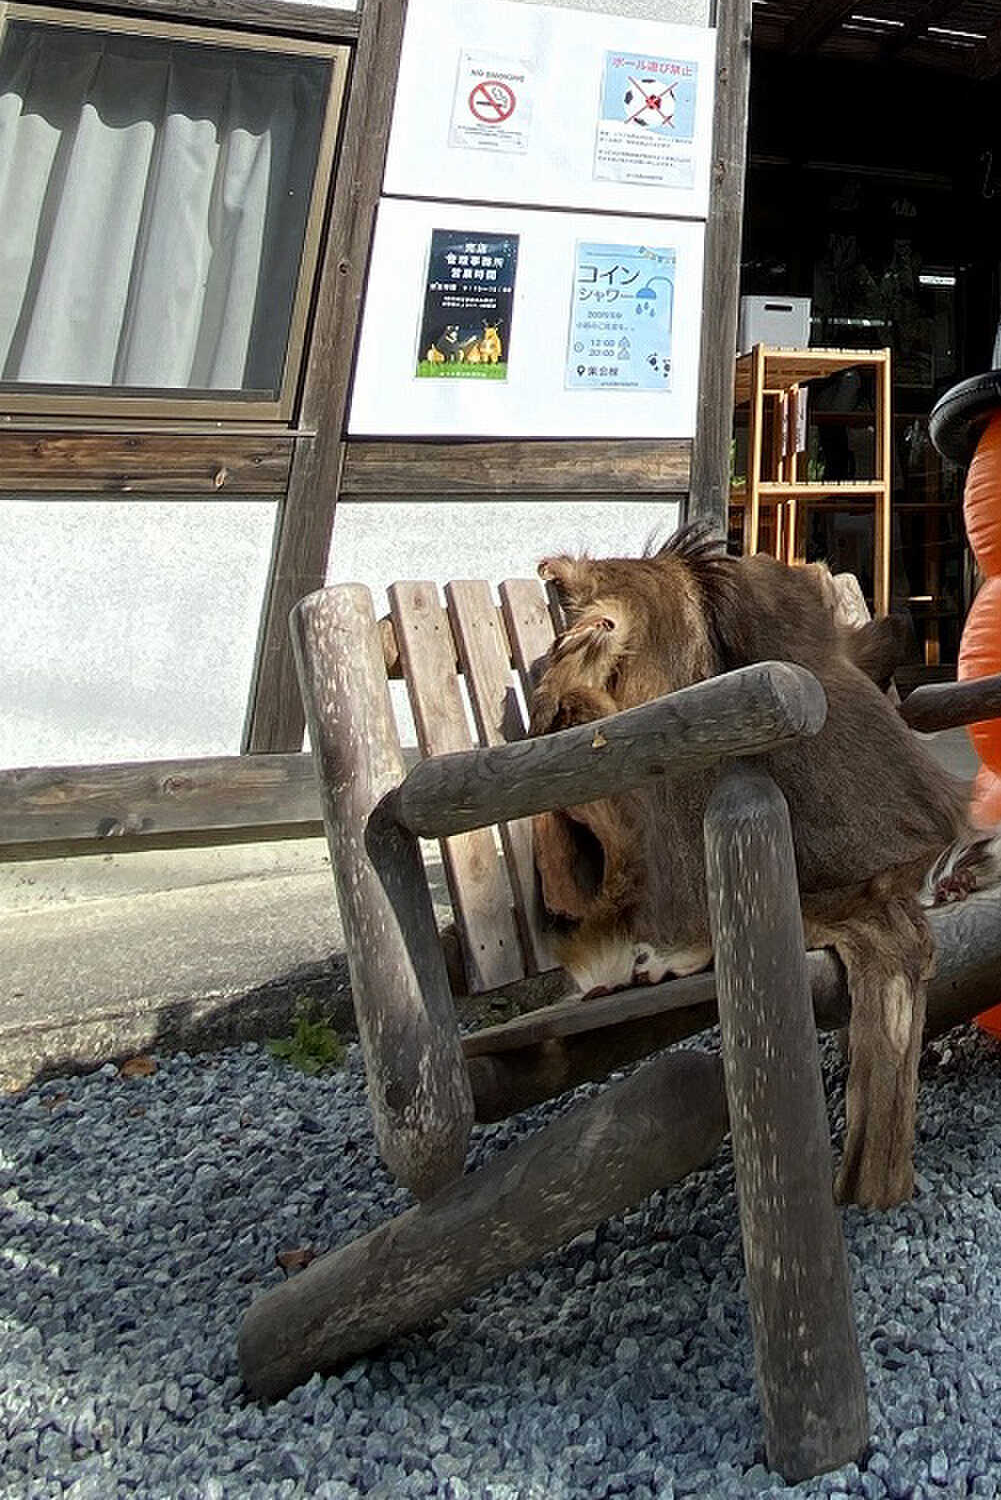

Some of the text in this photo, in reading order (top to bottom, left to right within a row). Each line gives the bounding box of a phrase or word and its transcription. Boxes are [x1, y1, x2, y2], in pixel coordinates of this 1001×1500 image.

[470, 68, 484, 77] NO
[612, 56, 693, 77] ボール遊び禁止
[578, 264, 640, 285] コイン
[579, 288, 634, 302] シャワー
